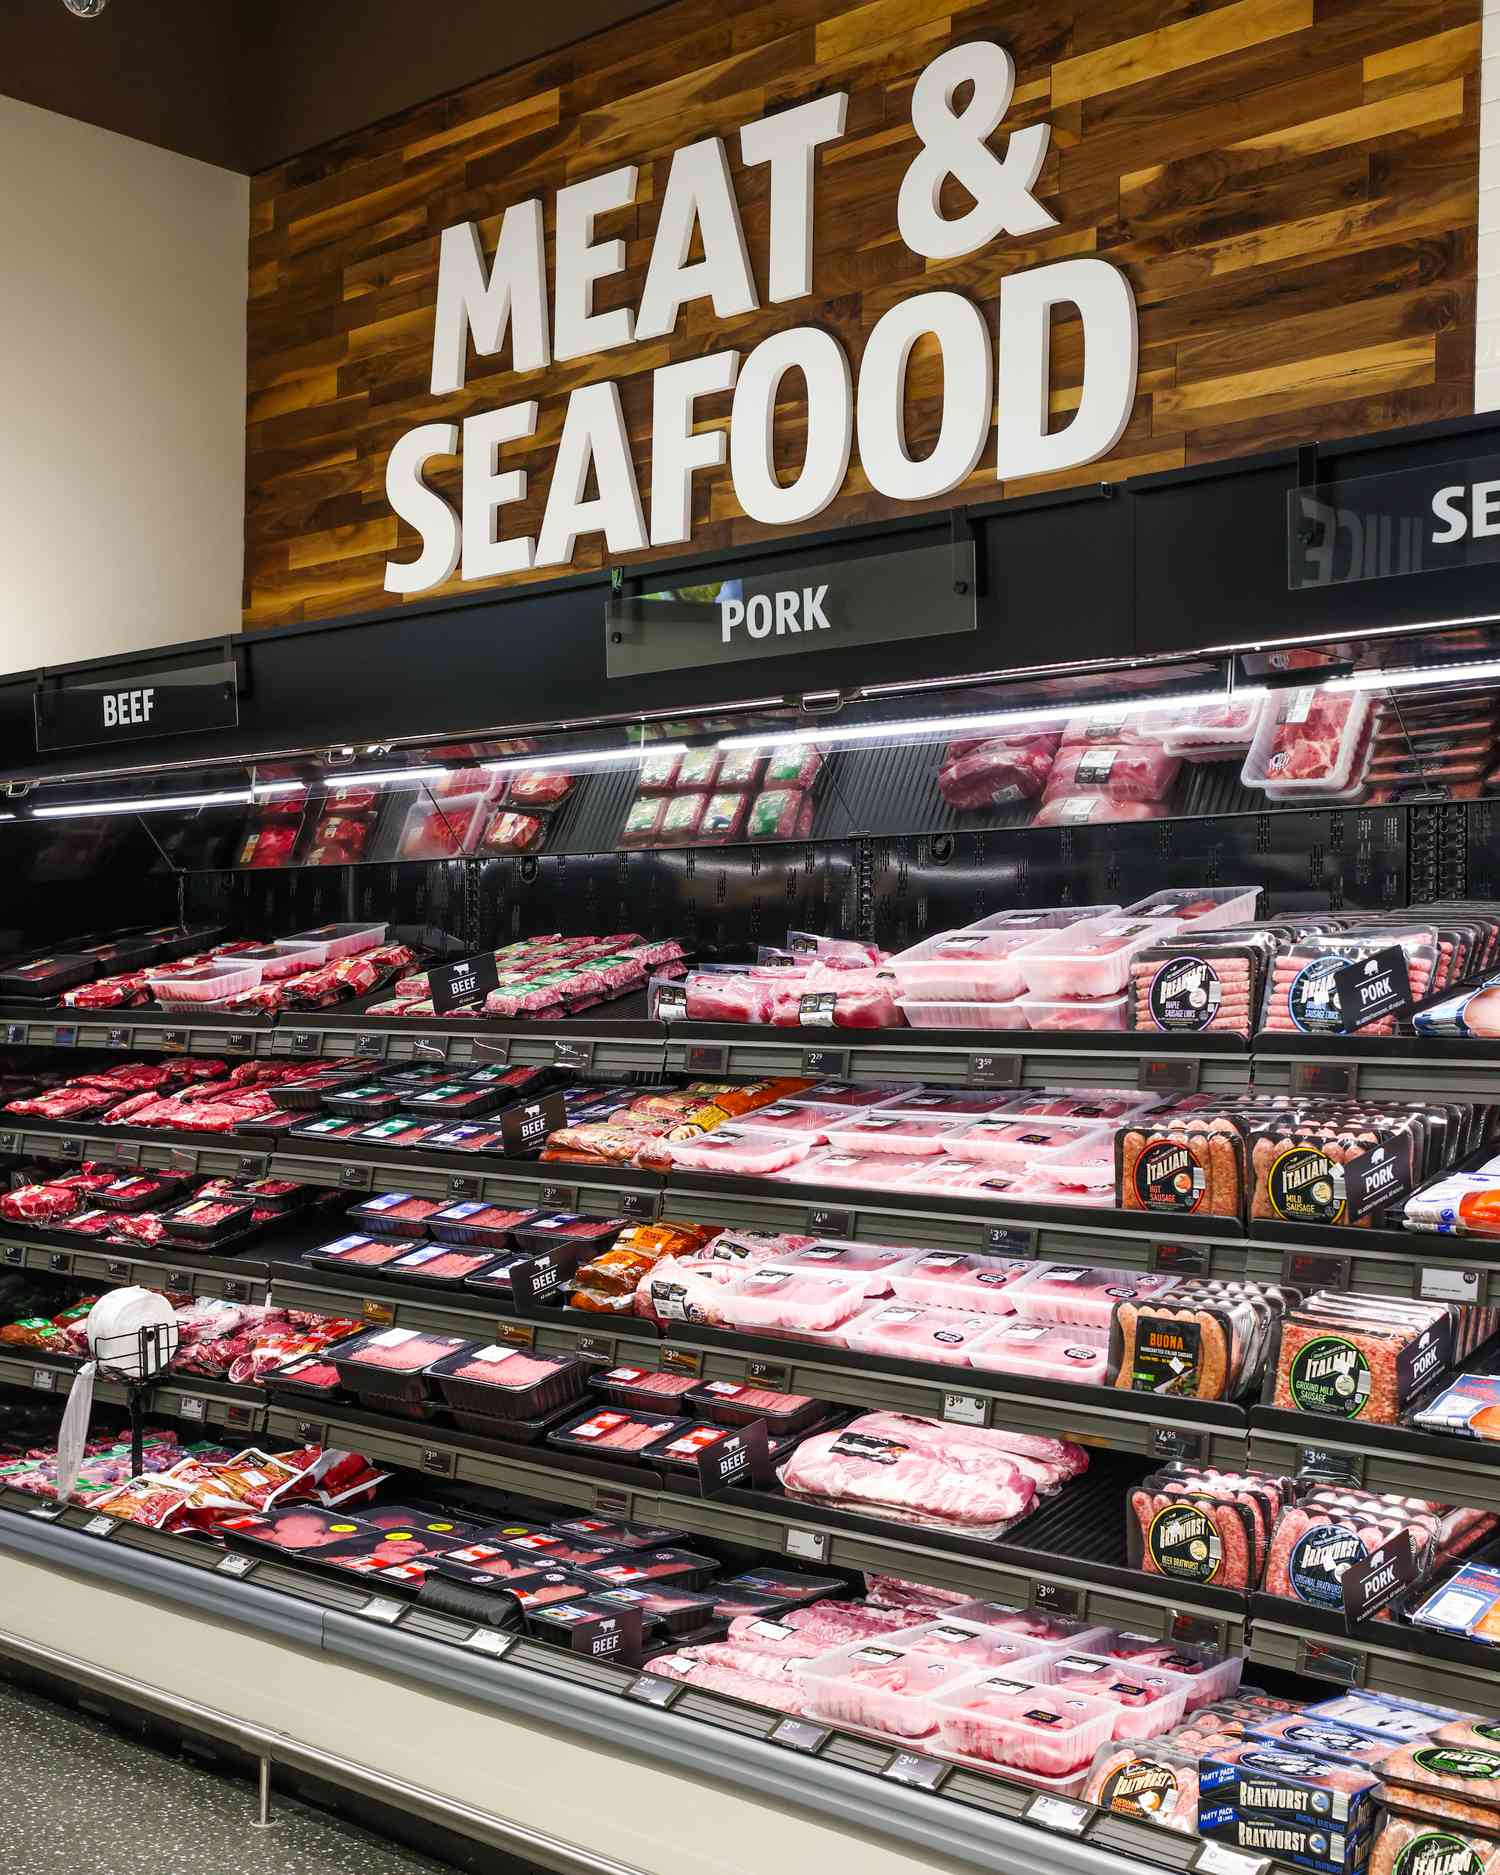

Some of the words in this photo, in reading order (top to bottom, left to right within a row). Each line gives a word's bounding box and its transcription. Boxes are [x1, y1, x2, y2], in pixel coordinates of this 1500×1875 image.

[430, 91, 848, 396] MEAT
[896, 41, 1059, 259] &
[383, 258, 1139, 594] SEAFOOD
[721, 584, 831, 643] PORK
[102, 688, 155, 728] BEEF
[450, 977, 479, 995] BEEF
[1360, 976, 1393, 1005] PORK
[521, 1117, 546, 1138] BEEF
[1146, 1150, 1188, 1185] ITALIAN
[1282, 1158, 1329, 1193] ITALIAN
[1365, 1164, 1394, 1193] PORK
[1285, 1194, 1302, 1203] MILD
[1285, 1202, 1315, 1213] SAUSAGE
[532, 1268, 558, 1291] BEEF
[1150, 1332, 1184, 1350] BUONA
[1412, 1346, 1438, 1379] PORK
[1296, 1380, 1318, 1392] GROUND
[1319, 1386, 1334, 1396] MILD
[1300, 1390, 1326, 1403] SAUSAGE
[720, 1451, 746, 1475] BEEF
[1301, 1540, 1359, 1568] BRATWURST
[1364, 1564, 1396, 1598] PORK
[592, 1634, 620, 1655] BEEF
[1112, 1773, 1169, 1797] BRATWURST
[1200, 1770, 1219, 1782] PARTY
[1219, 1766, 1236, 1777] PACK
[1239, 1781, 1308, 1811] BRATWURST
[1200, 1810, 1219, 1822] PARTY
[1218, 1807, 1233, 1817] PACK
[1238, 1821, 1306, 1853] BRATWURST
